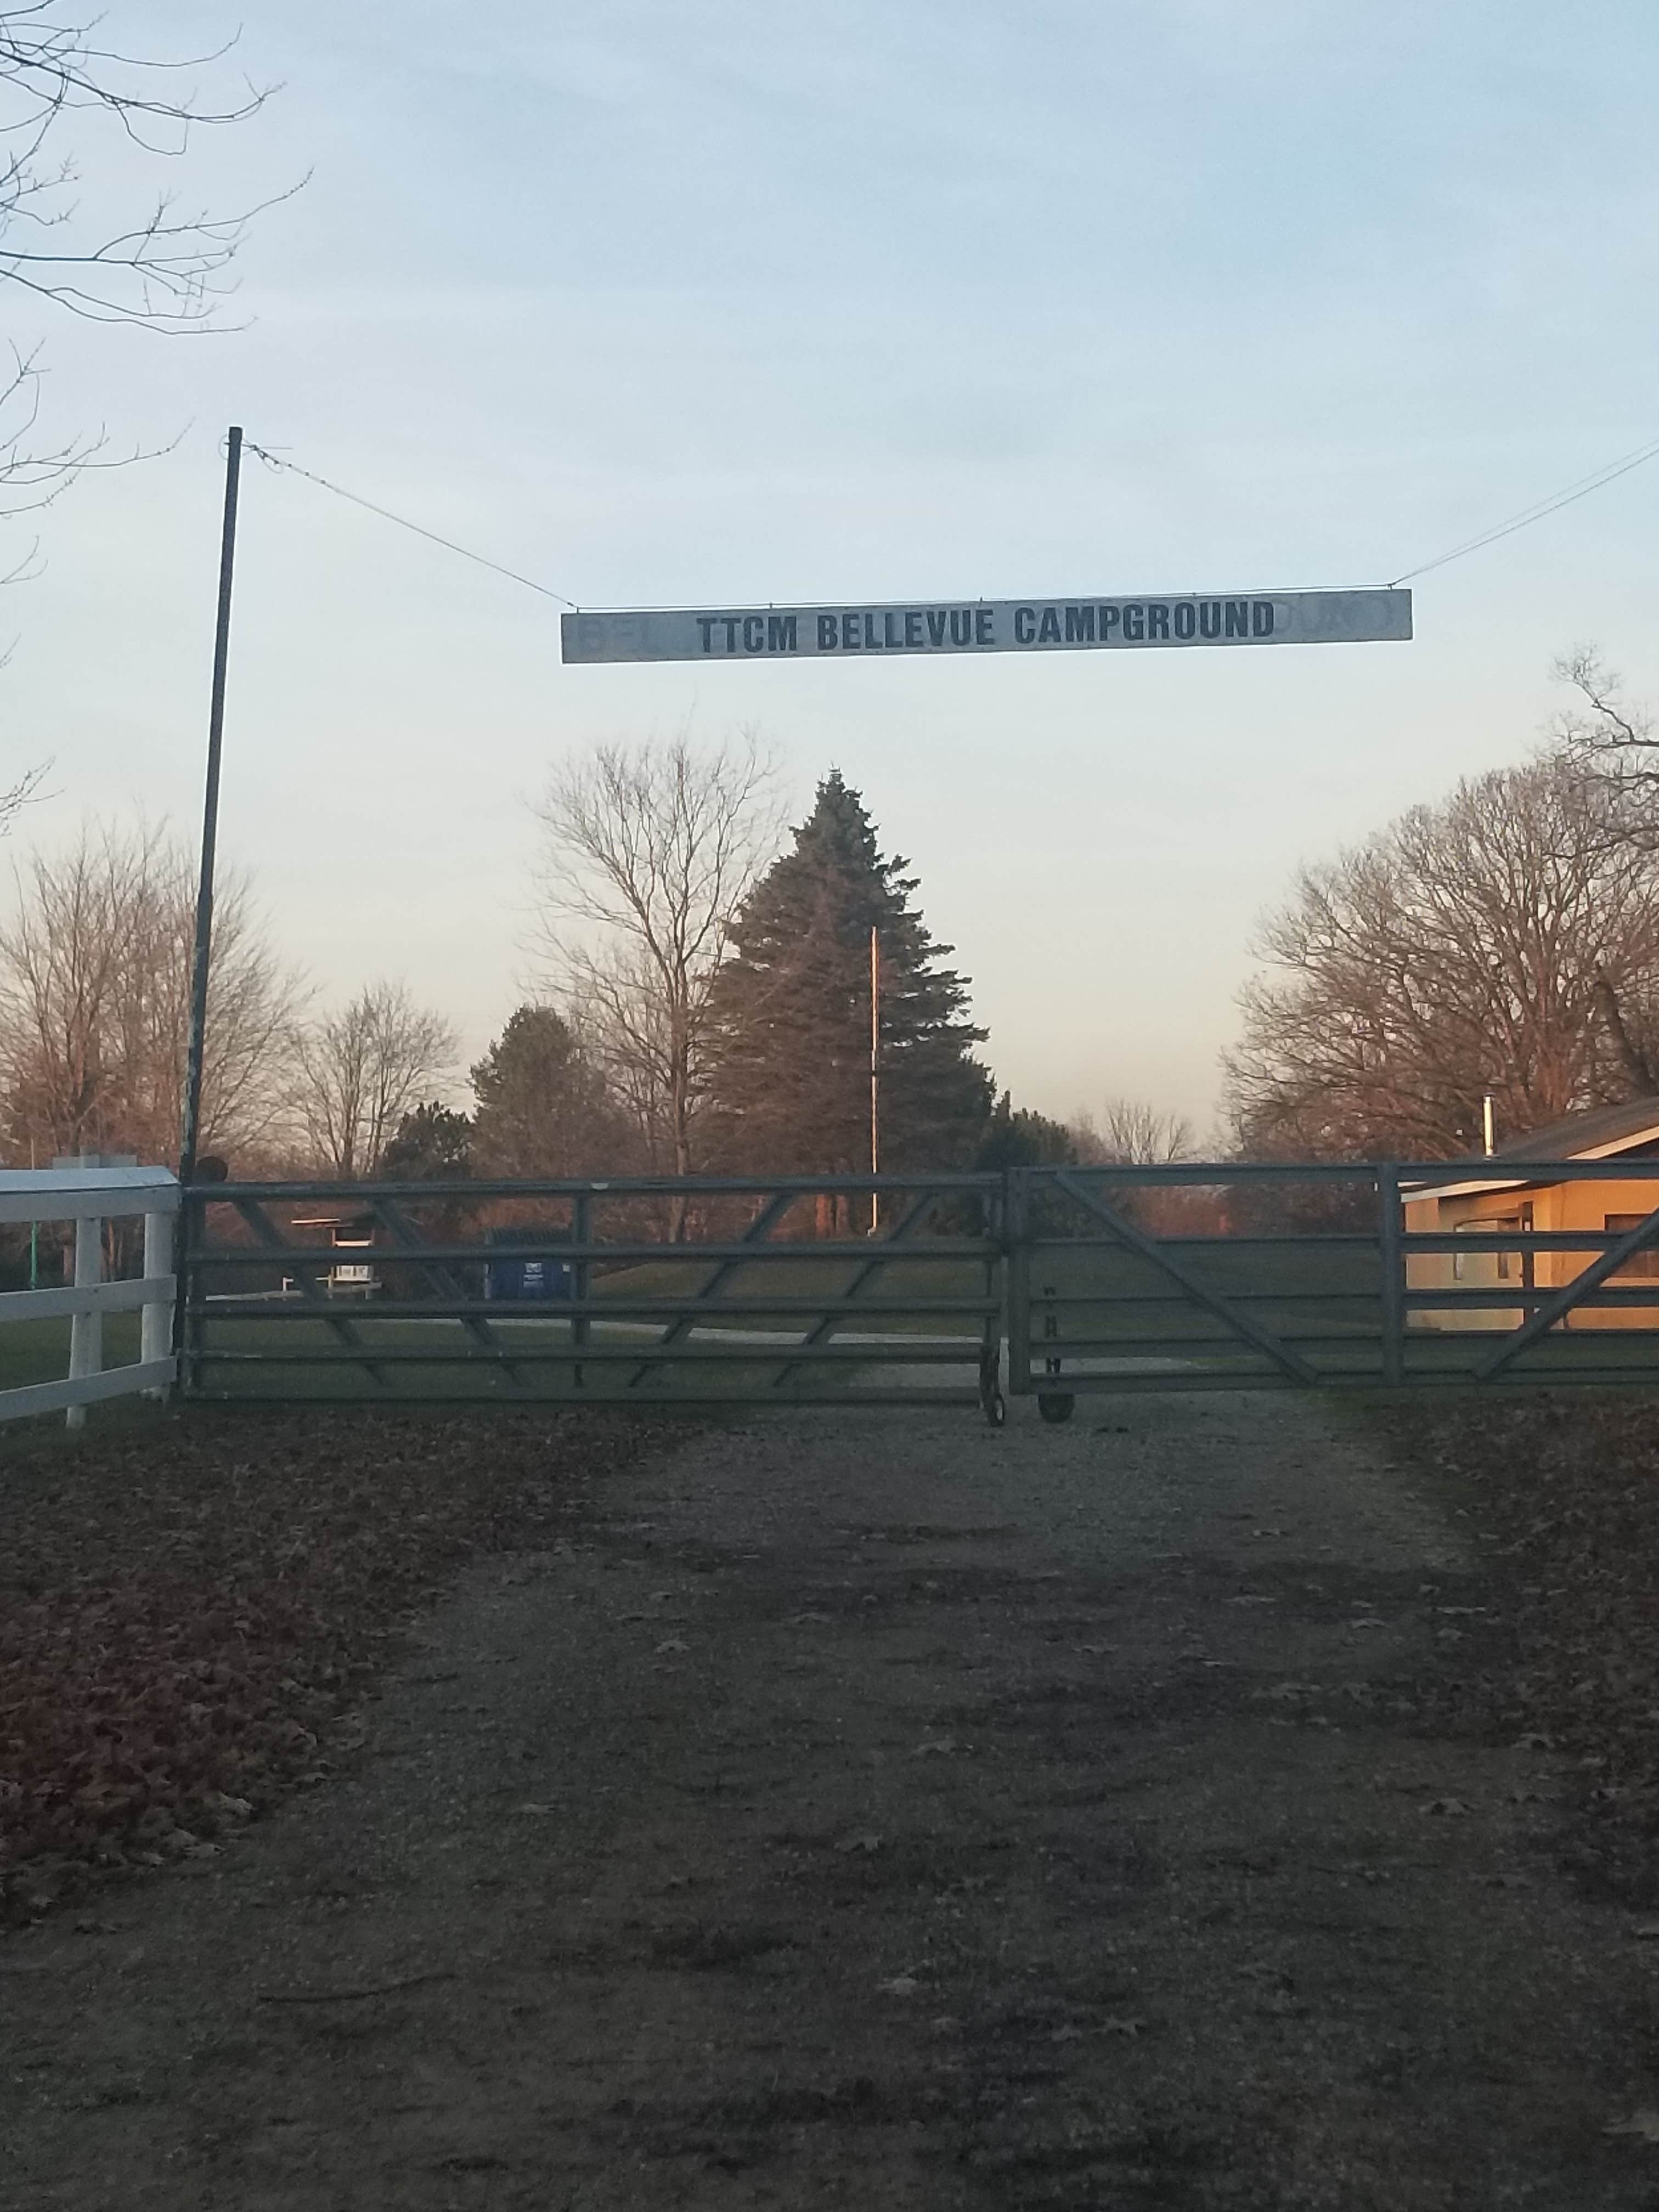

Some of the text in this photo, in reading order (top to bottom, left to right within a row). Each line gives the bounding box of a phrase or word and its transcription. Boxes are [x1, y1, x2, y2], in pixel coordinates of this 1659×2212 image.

[696, 615, 797, 653] TTCM
[817, 609, 995, 651] BELLEVUE
[1014, 601, 1274, 645] CAMPGROUND
